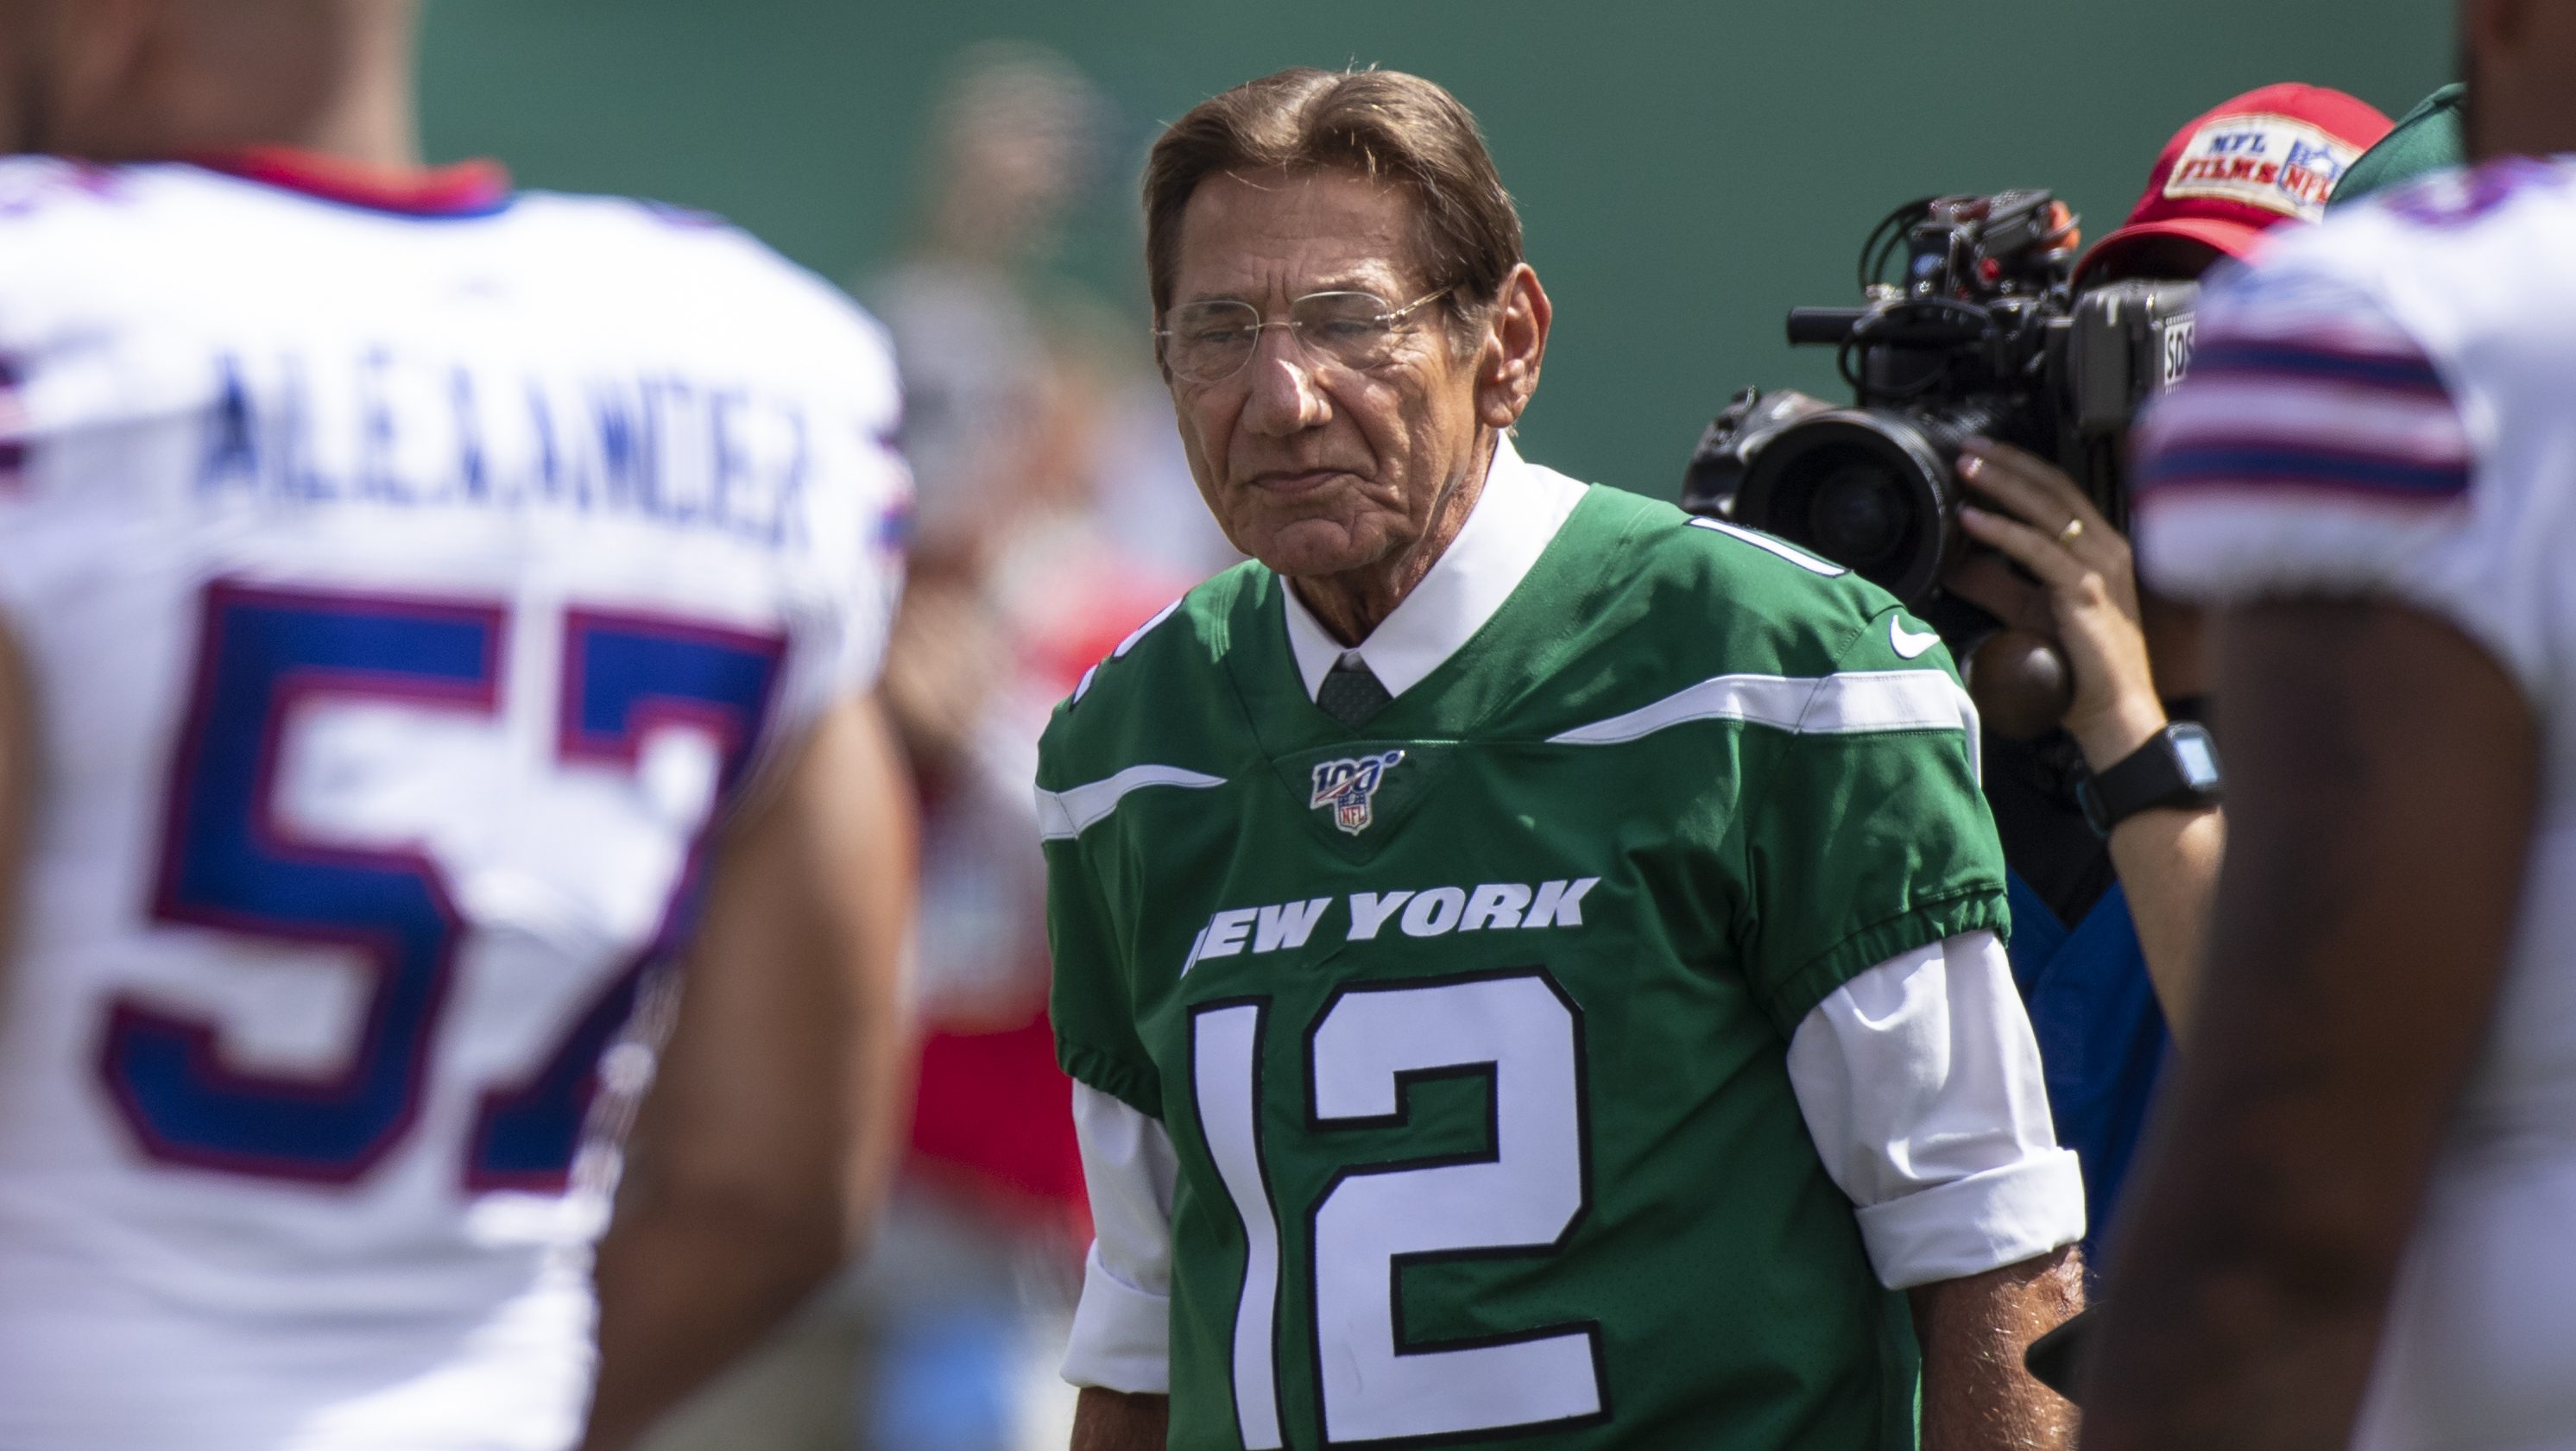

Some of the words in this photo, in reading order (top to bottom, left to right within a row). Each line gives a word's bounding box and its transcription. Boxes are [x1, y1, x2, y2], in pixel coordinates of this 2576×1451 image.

[2208, 132, 2267, 155] NFL
[2175, 157, 2279, 185] FILMS
[2282, 161, 2333, 205] NFL
[1316, 760, 1381, 794] 100
[1341, 806, 1365, 825] NFL
[98, 578, 790, 1195] 57
[1180, 898, 1332, 980] EW
[1346, 877, 1601, 942] YORK
[1187, 965, 1613, 1451] 12
